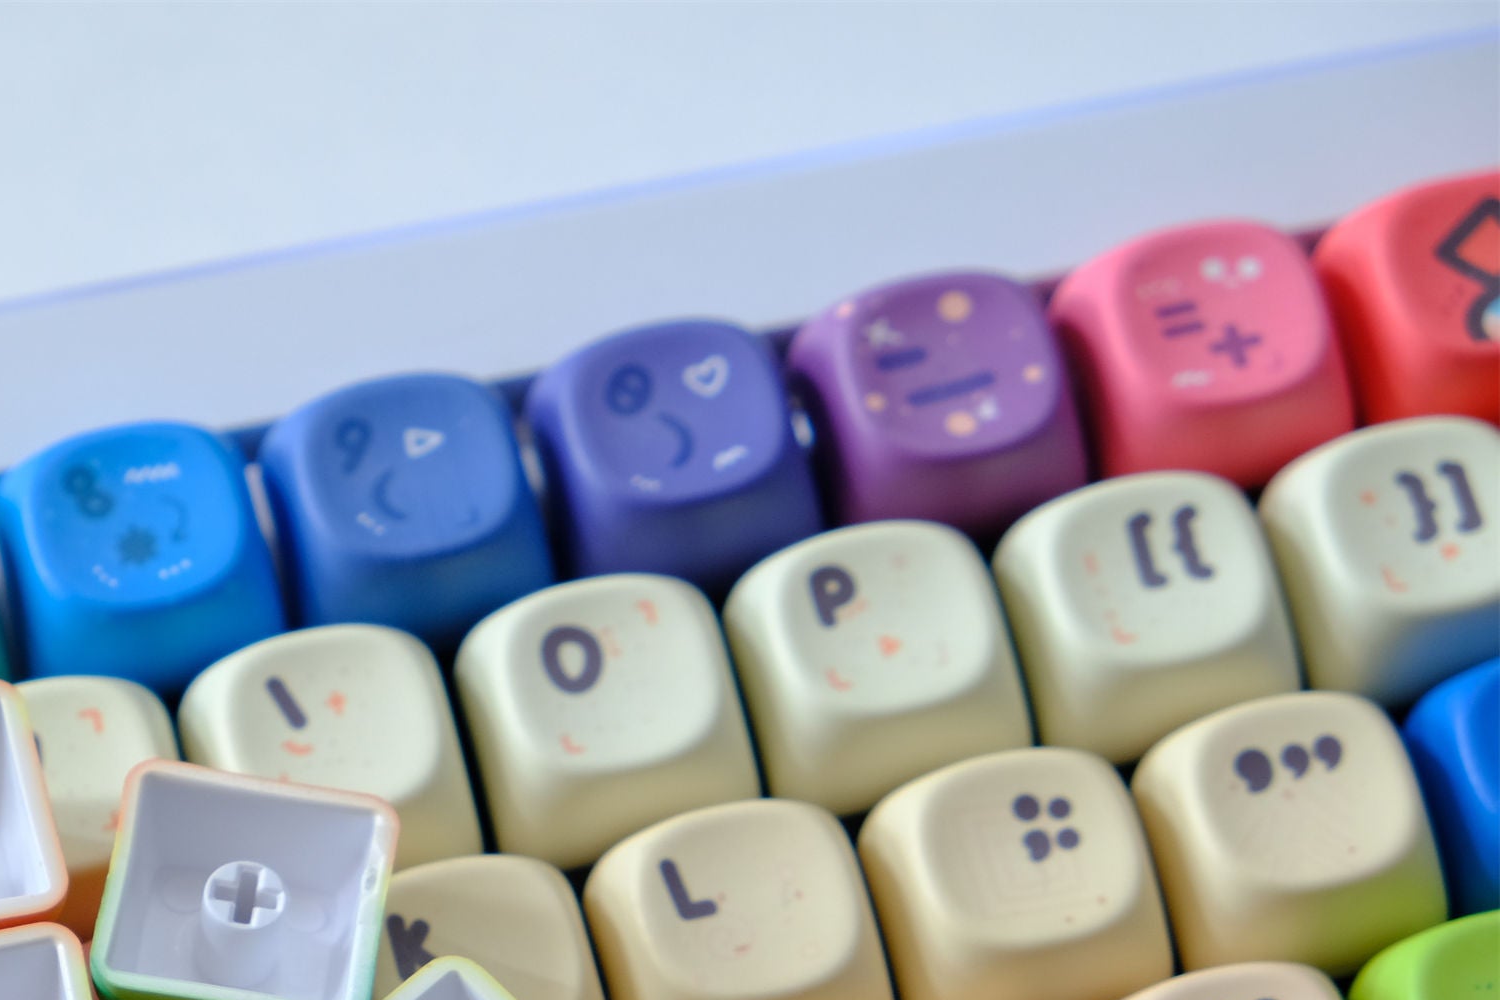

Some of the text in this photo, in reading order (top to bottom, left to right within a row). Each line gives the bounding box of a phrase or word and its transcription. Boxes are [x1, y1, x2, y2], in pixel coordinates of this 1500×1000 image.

[335, 417, 373, 476] 9
[809, 564, 857, 629] P
[658, 857, 719, 921] L
[386, 913, 437, 981] K
